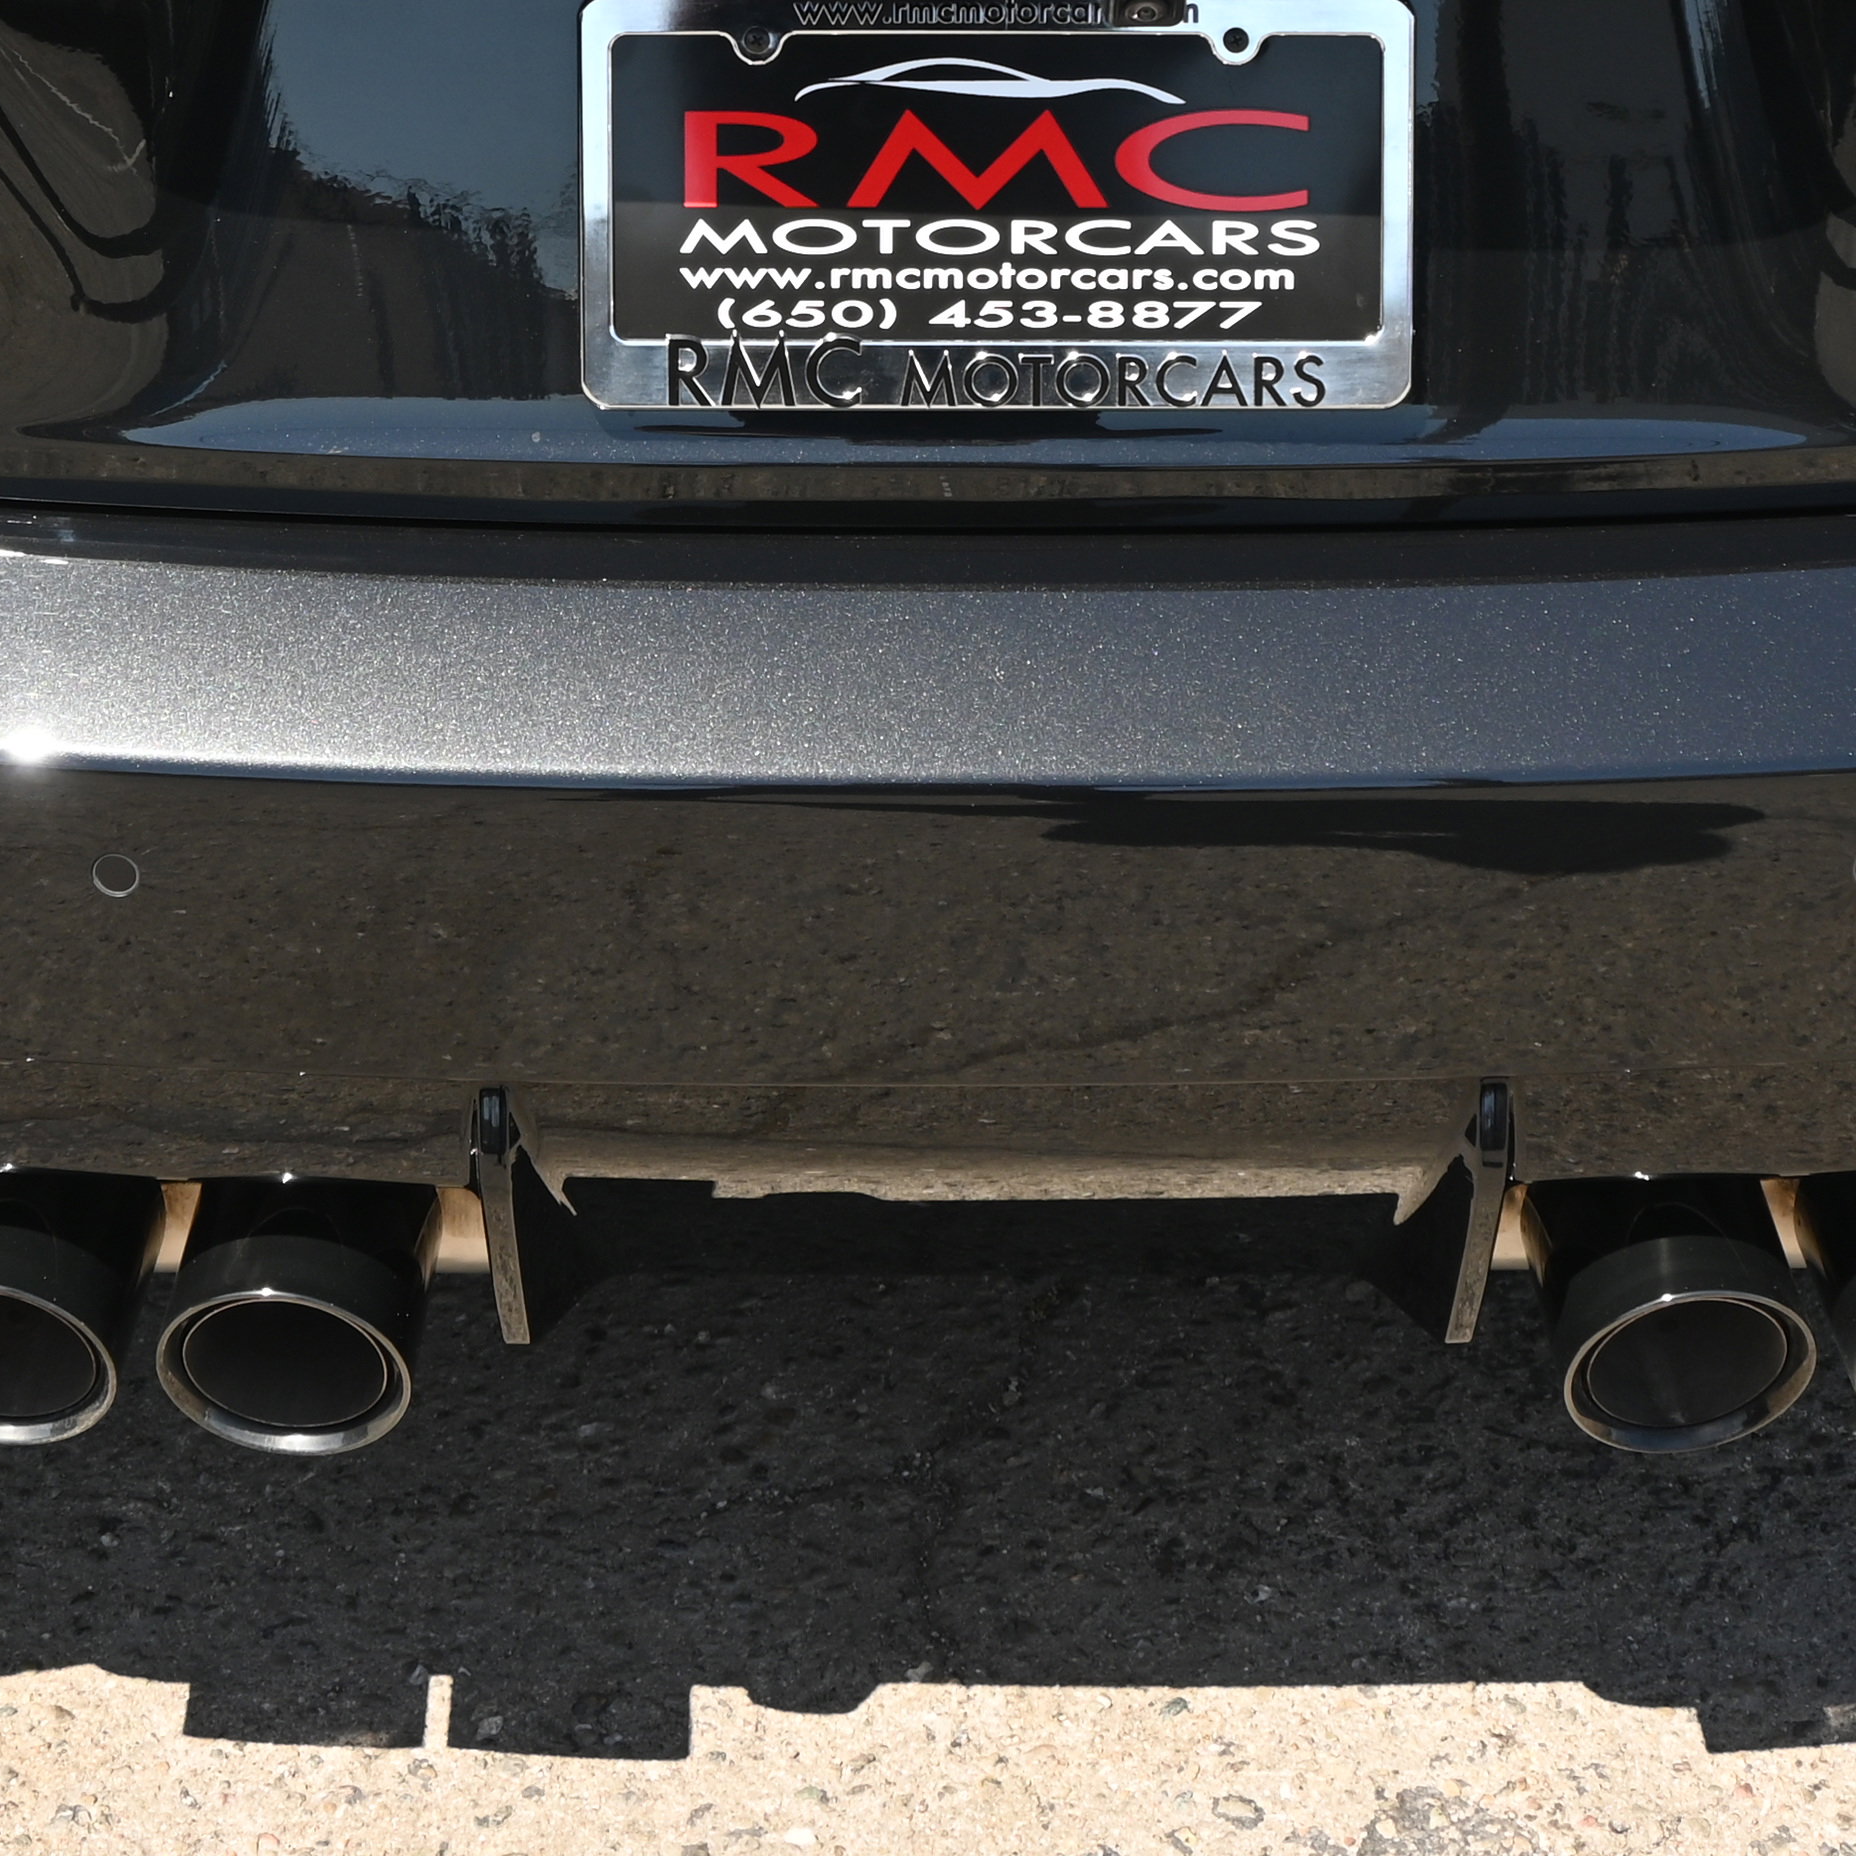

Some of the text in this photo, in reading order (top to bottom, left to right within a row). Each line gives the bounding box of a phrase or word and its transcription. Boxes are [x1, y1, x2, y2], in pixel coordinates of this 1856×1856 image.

[684, 107, 1310, 212] RMC
[679, 217, 1322, 257] MOTORCARS
[678, 261, 1296, 291] www.rmcmotorcars.com
[716, 297, 1264, 330] (650) 453-8877
[665, 330, 1327, 409] RMC MOTORCARS
